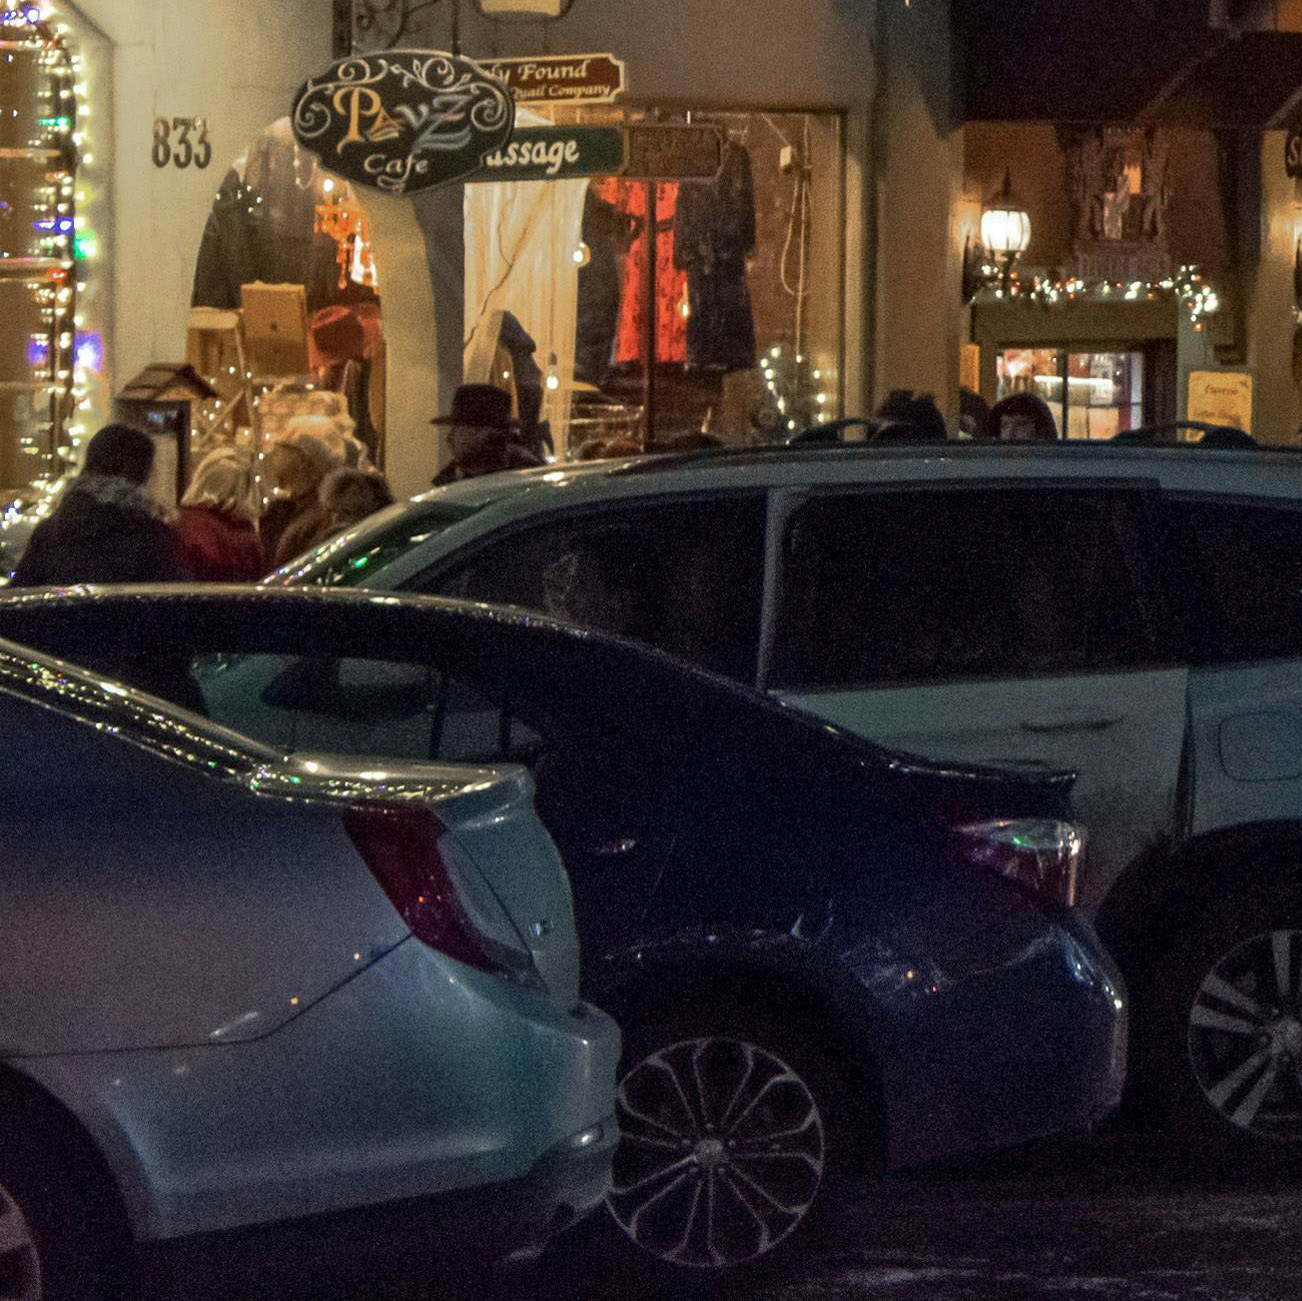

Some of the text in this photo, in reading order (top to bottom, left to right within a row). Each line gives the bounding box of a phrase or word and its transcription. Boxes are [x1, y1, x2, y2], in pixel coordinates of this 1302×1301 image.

[518, 59, 591, 81] Found
[549, 85, 610, 99] Company
[152, 117, 212, 168] 833
[486, 140, 580, 174] assage
